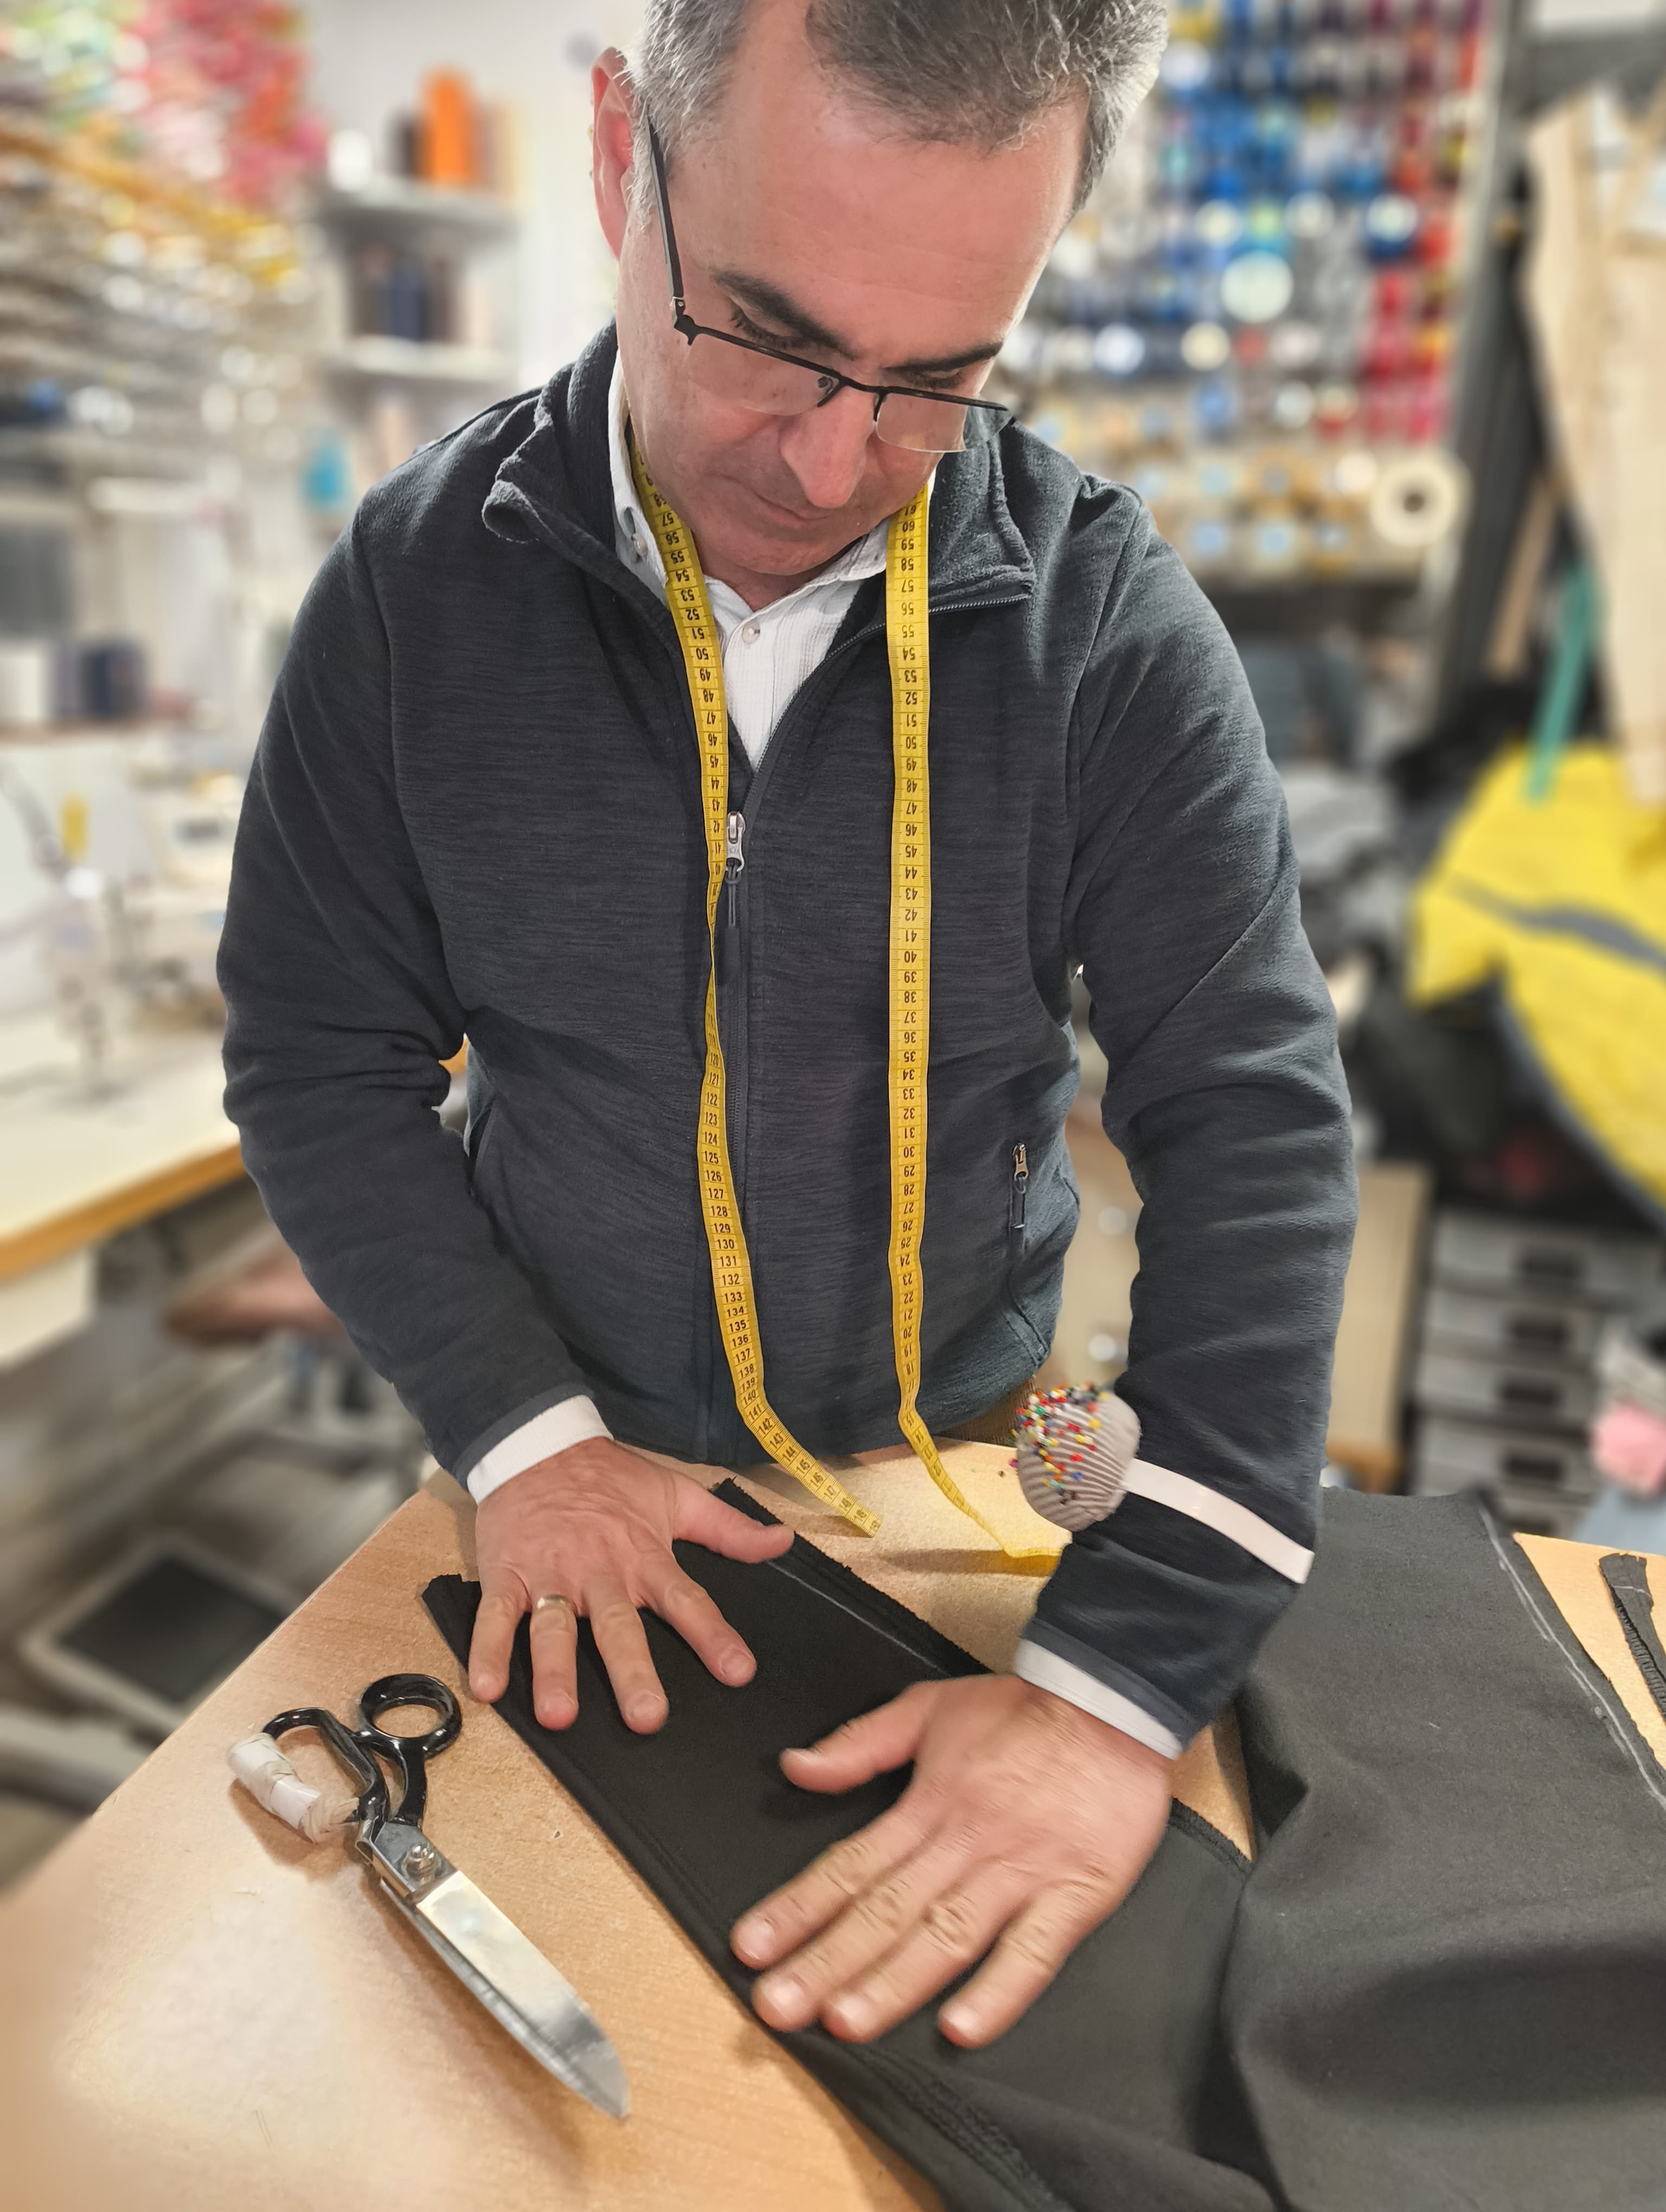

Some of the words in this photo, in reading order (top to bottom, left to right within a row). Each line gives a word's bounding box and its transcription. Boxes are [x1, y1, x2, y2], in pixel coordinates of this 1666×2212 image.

[662, 512, 675, 526] 57
[902, 520, 915, 532] 60
[665, 531, 680, 545] 56
[901, 539, 914, 551] 59
[670, 551, 684, 564] 55
[901, 558, 914, 571] 58
[676, 569, 690, 582] 54
[901, 579, 914, 593] 57
[680, 589, 695, 602] 53
[685, 608, 700, 620] 52
[901, 602, 914, 615] 56
[692, 628, 704, 639] 51
[902, 625, 914, 638] 55
[696, 648, 709, 660] 50
[902, 647, 915, 660] 54
[700, 667, 711, 681] 49
[904, 670, 917, 683] 53
[703, 690, 714, 703] 48
[906, 692, 918, 705] 52
[707, 712, 716, 724] 47
[906, 713, 917, 727] 51
[708, 733, 717, 747] 46
[906, 736, 917, 749] 50
[710, 754, 719, 768] 45
[906, 758, 917, 771] 49
[711, 777, 720, 790] 44
[906, 779, 918, 793] 48
[712, 799, 720, 812] 43
[906, 801, 918, 815] 47
[714, 820, 720, 833] 42
[906, 824, 918, 837] 46
[714, 841, 721, 854] 41
[905, 845, 918, 858] 45
[715, 863, 721, 876] 40
[905, 866, 918, 879] 44
[906, 888, 918, 900] 43
[905, 909, 918, 921] 42
[905, 930, 917, 942] 41
[904, 950, 917, 963] 40
[904, 971, 917, 983] 39
[904, 991, 917, 1004] 38
[904, 1011, 916, 1024] 37
[904, 1031, 916, 1044] 36
[904, 1051, 916, 1062] 35
[709, 1072, 719, 1085] 121
[903, 1069, 915, 1081] 34
[707, 1092, 718, 1106] 122
[903, 1088, 914, 1100] 33
[706, 1111, 717, 1126] 123
[904, 1108, 915, 1120] 32
[704, 1131, 718, 1146] 124
[904, 1127, 915, 1139] 31
[704, 1150, 719, 1165] 125
[904, 1146, 915, 1158] 30
[706, 1169, 722, 1182] 126
[904, 1166, 915, 1177] 29
[708, 1187, 724, 1199] 127
[904, 1184, 914, 1195] 28
[711, 1206, 728, 1217] 128
[904, 1202, 914, 1214] 27
[714, 1223, 731, 1233] 129
[903, 1220, 913, 1232] 26
[717, 1239, 735, 1249] 130
[901, 1236, 912, 1249] 25
[720, 1256, 737, 1268] 131
[900, 1253, 910, 1267] 24
[722, 1273, 740, 1286] 132
[903, 1273, 912, 1286] 23
[724, 1293, 742, 1303] 133
[904, 1291, 913, 1304] 22
[727, 1306, 745, 1318] 134
[904, 1309, 913, 1322] 21
[729, 1320, 746, 1333] 135
[904, 1326, 912, 1339] 20
[732, 1334, 749, 1347] 136
[735, 1348, 751, 1363] 137
[905, 1344, 912, 1357] 19
[739, 1364, 754, 1378] 138
[907, 1362, 914, 1375] 18
[741, 1377, 755, 1391] 139
[743, 1389, 756, 1405] 140
[748, 1404, 762, 1420] 141
[758, 1418, 773, 1435] 142
[770, 1432, 784, 1449] 143
[783, 1446, 797, 1462] 144
[796, 1459, 810, 1474] 145
[810, 1472, 824, 1487] 146
[824, 1485, 837, 1499] 147
